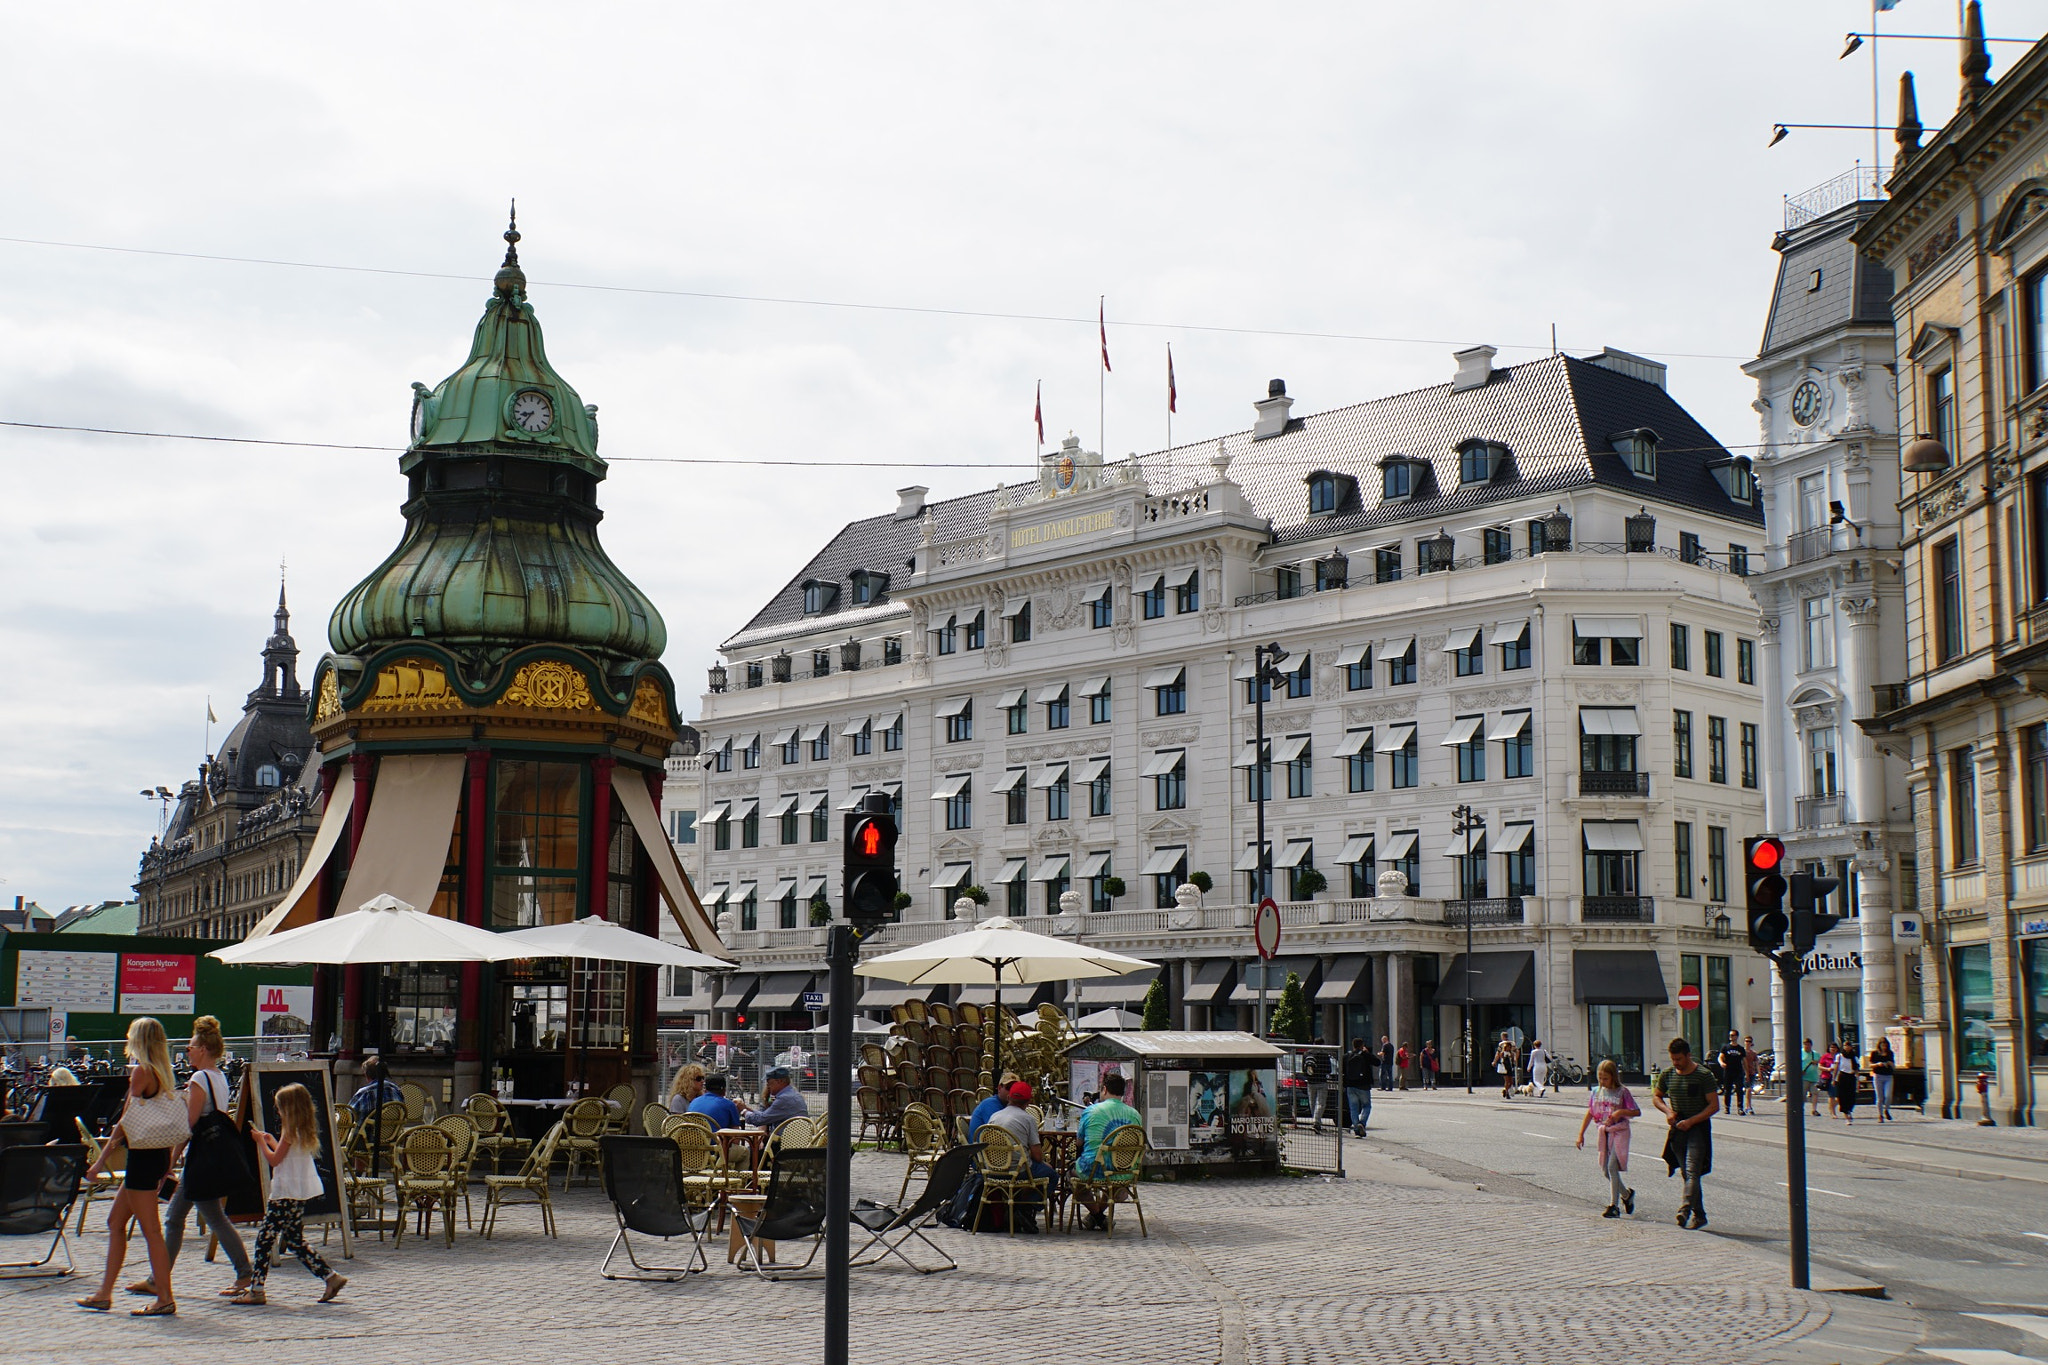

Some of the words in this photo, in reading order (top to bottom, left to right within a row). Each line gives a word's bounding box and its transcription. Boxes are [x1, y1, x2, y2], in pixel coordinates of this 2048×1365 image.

[1011, 526, 1042, 548] HÔTEL
[1043, 510, 1115, 541] D'ANGLETERRE
[127, 958, 155, 968] Kongens
[156, 959, 179, 968] Nytorv
[1801, 952, 1858, 973] ydbank
[53, 1021, 62, 1029] 20
[1251, 1116, 1275, 1124] TESTINO
[1231, 1124, 1245, 1134] NO
[1246, 1123, 1275, 1134] LIMITS
